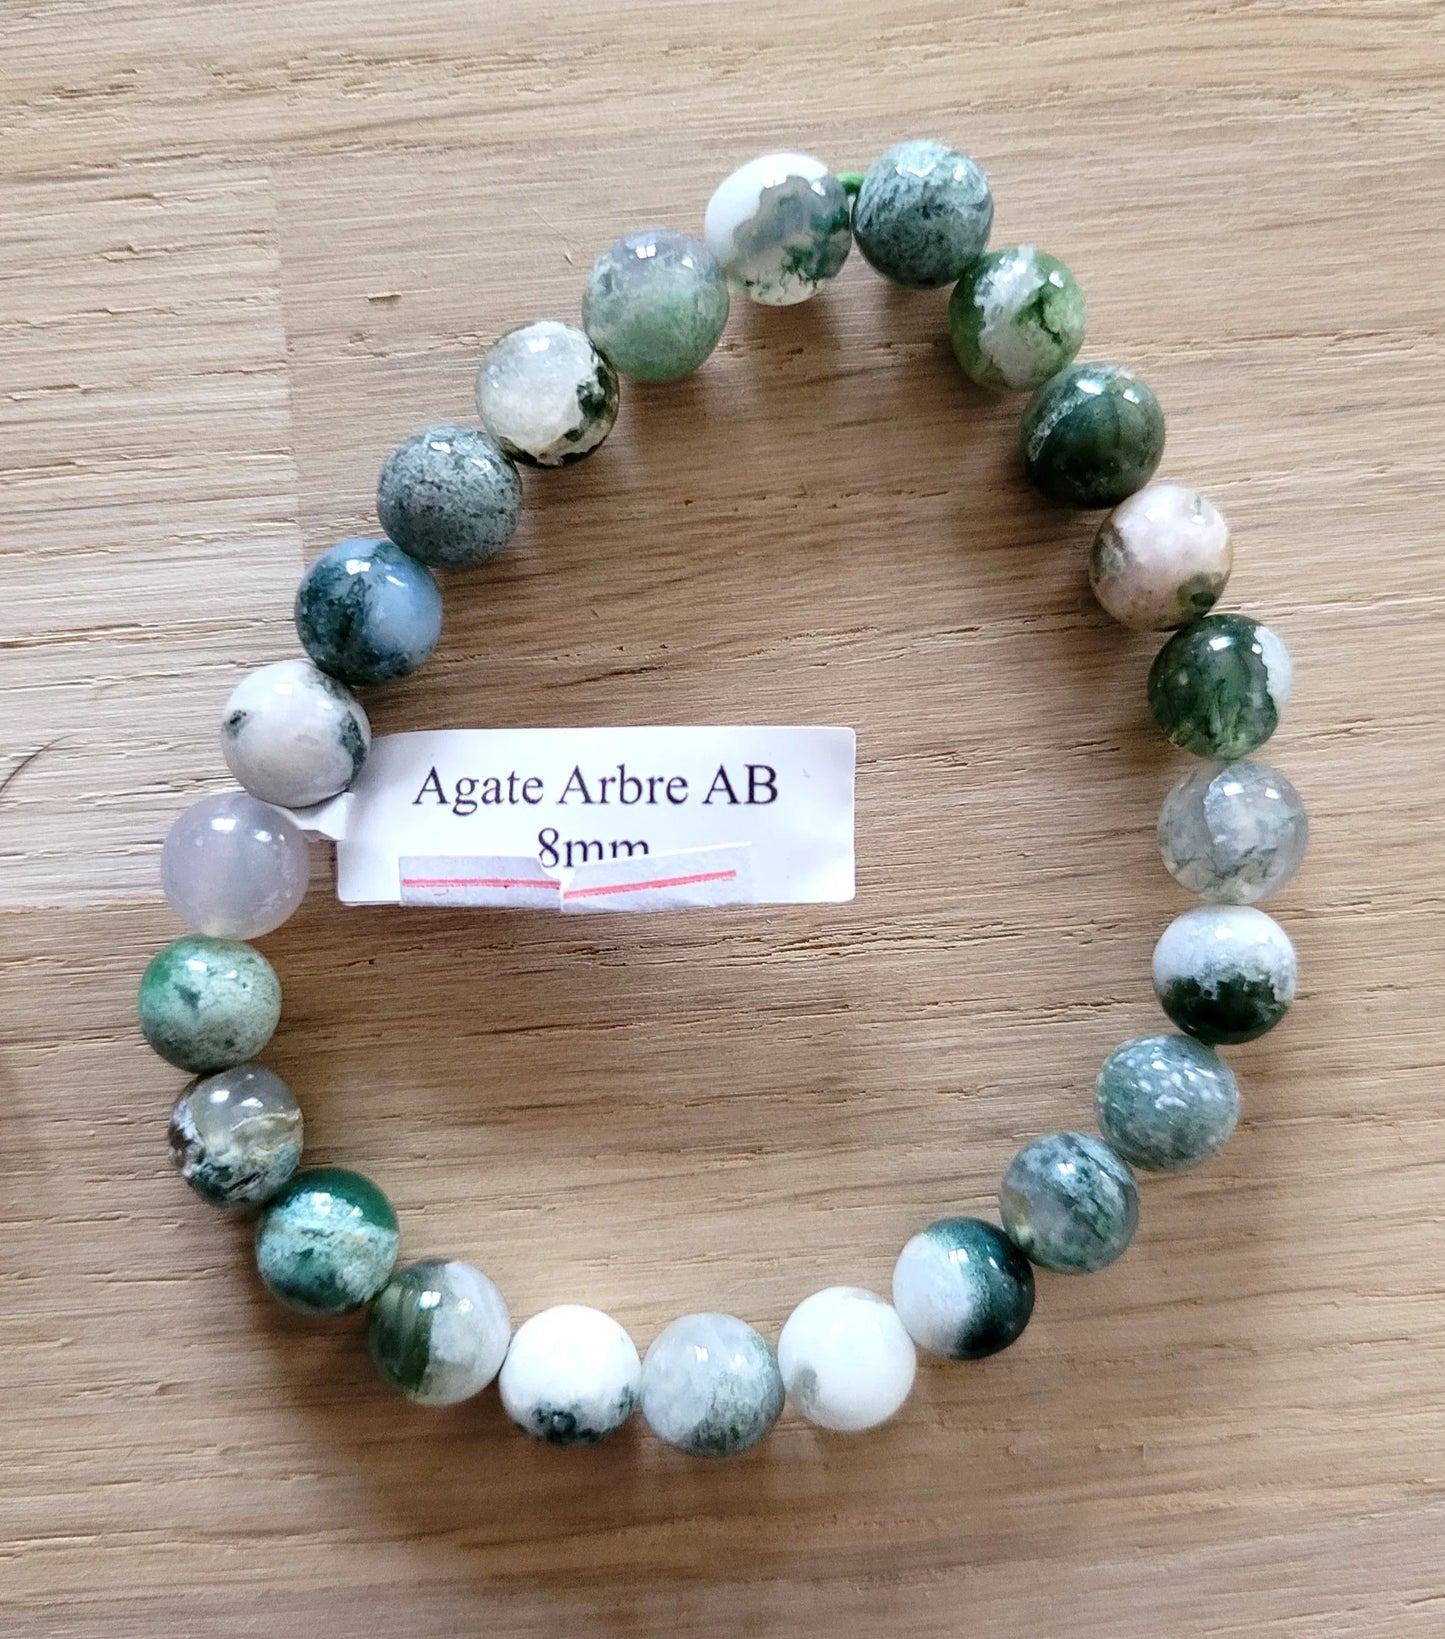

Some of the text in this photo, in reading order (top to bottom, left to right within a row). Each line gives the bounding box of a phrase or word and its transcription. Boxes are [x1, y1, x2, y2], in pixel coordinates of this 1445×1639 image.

[412, 764, 778, 816] Agate Arbre AB
[538, 827, 649, 868] 8mm
